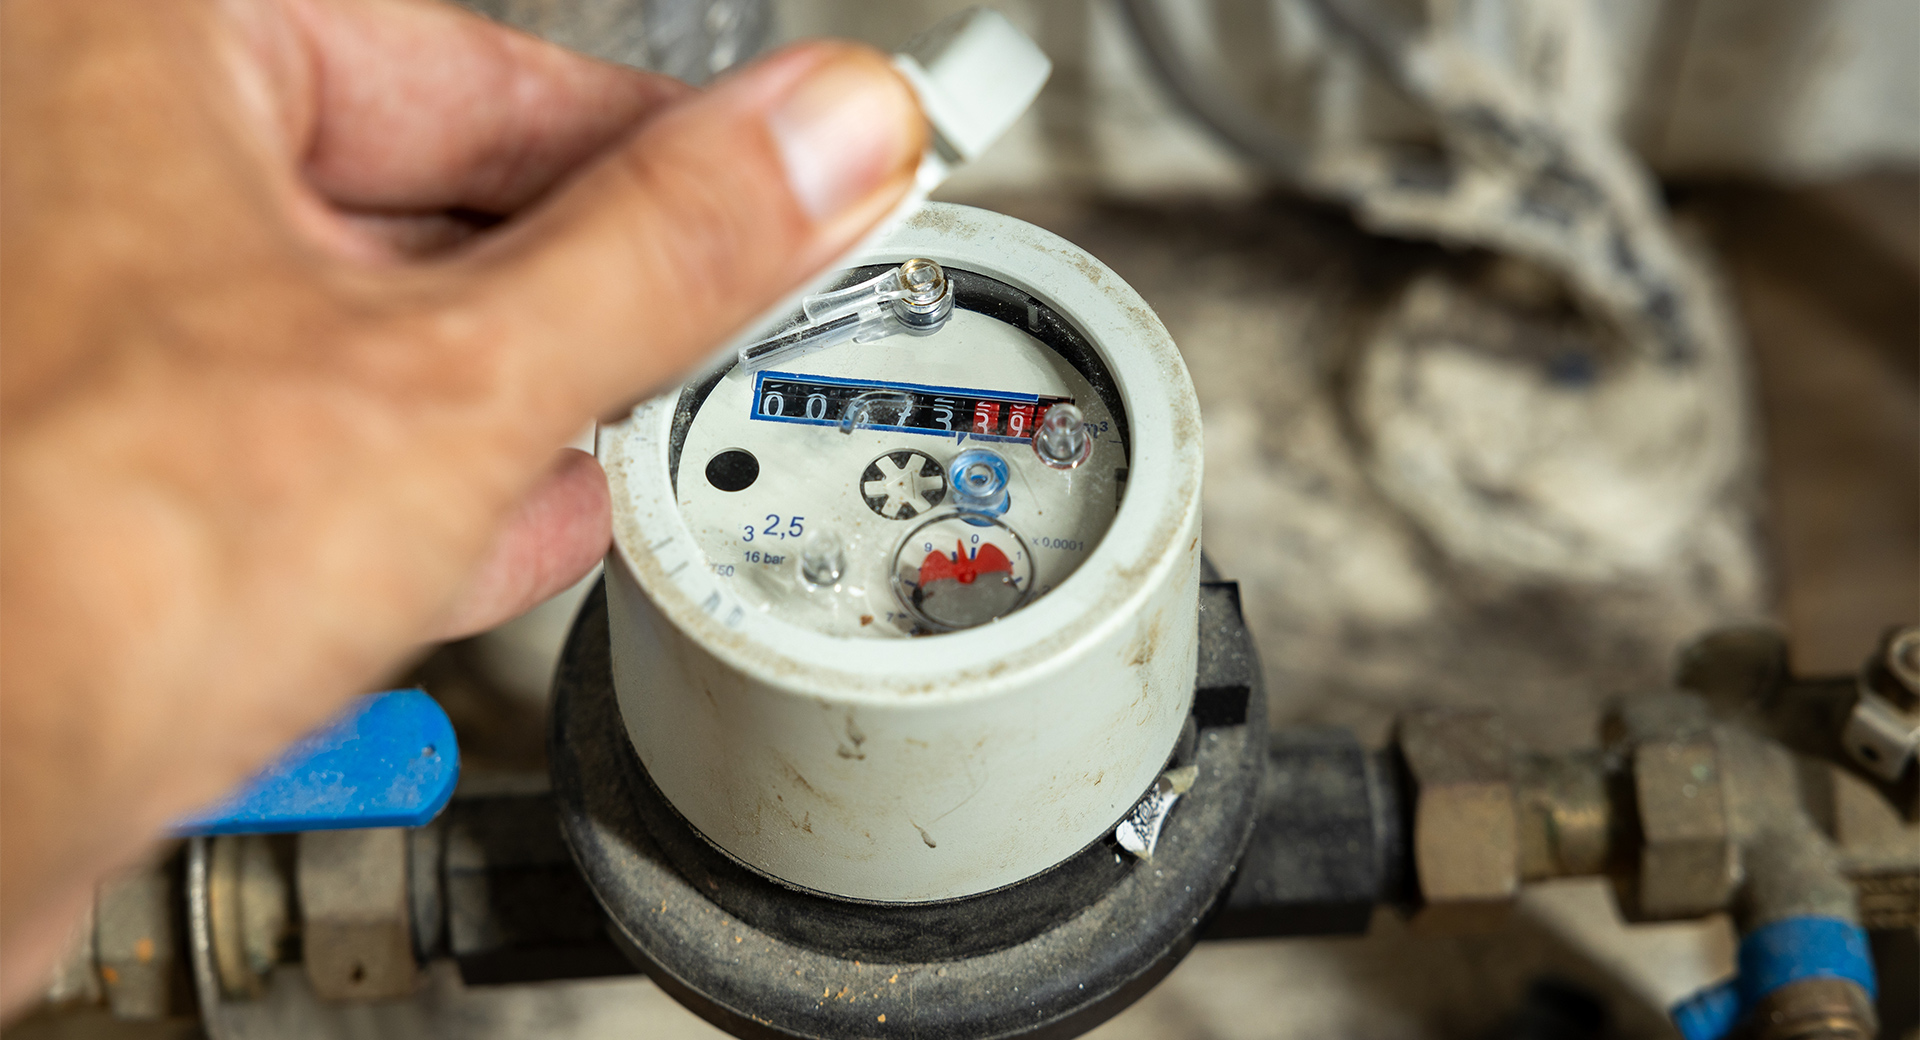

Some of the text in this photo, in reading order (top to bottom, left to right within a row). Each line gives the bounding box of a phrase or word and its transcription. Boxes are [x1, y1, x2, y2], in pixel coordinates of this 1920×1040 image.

[763, 514, 805, 540] 2,5
[971, 534, 979, 544] 0
[924, 543, 933, 552] 9
[744, 551, 785, 565] 16 bar
